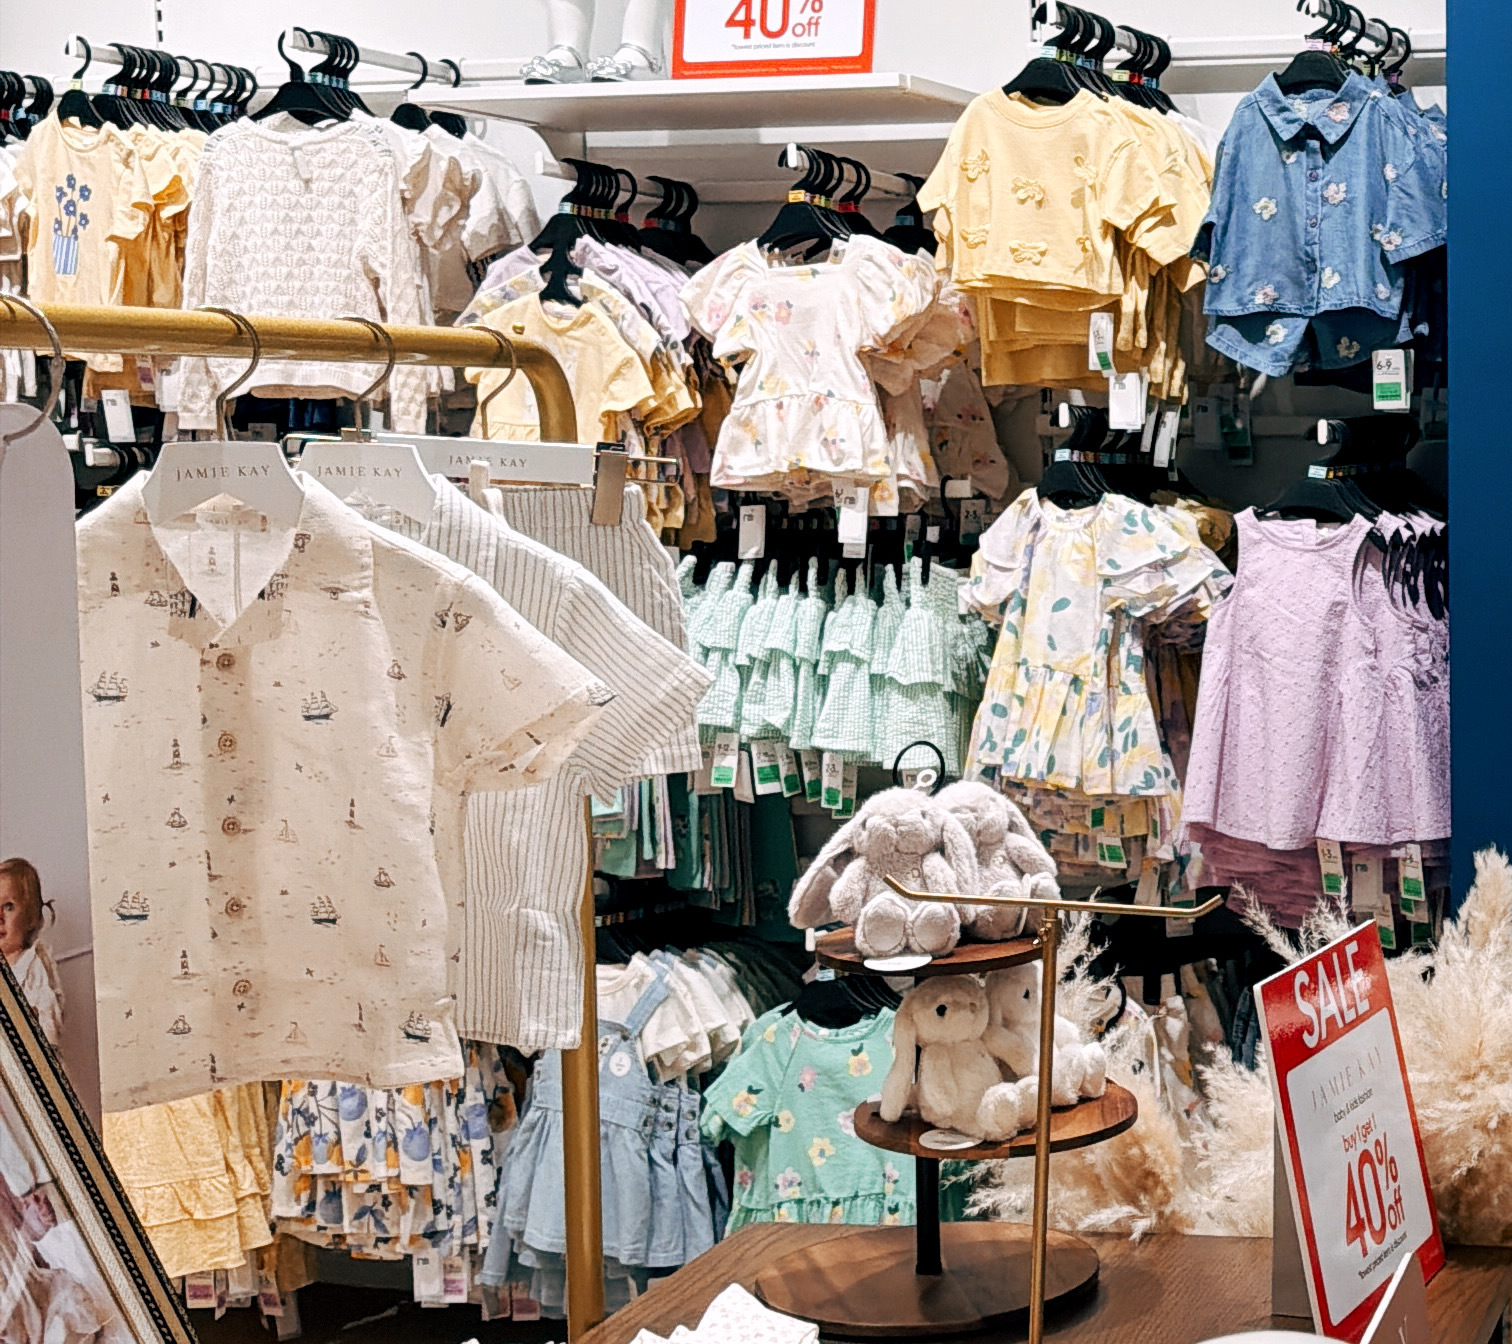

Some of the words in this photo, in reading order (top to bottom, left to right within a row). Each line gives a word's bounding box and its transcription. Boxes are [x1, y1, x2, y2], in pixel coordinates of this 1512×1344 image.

[791, 16, 822, 38] off
[176, 466, 229, 481] JAMIE
[238, 465, 271, 477] KAY
[316, 465, 366, 478] JAMIE
[373, 467, 402, 479] KAY
[500, 458, 527, 468] KAY
[1294, 940, 1370, 1048] SALE
[1346, 1131, 1399, 1258] 40%
[1387, 1184, 1406, 1231] off
